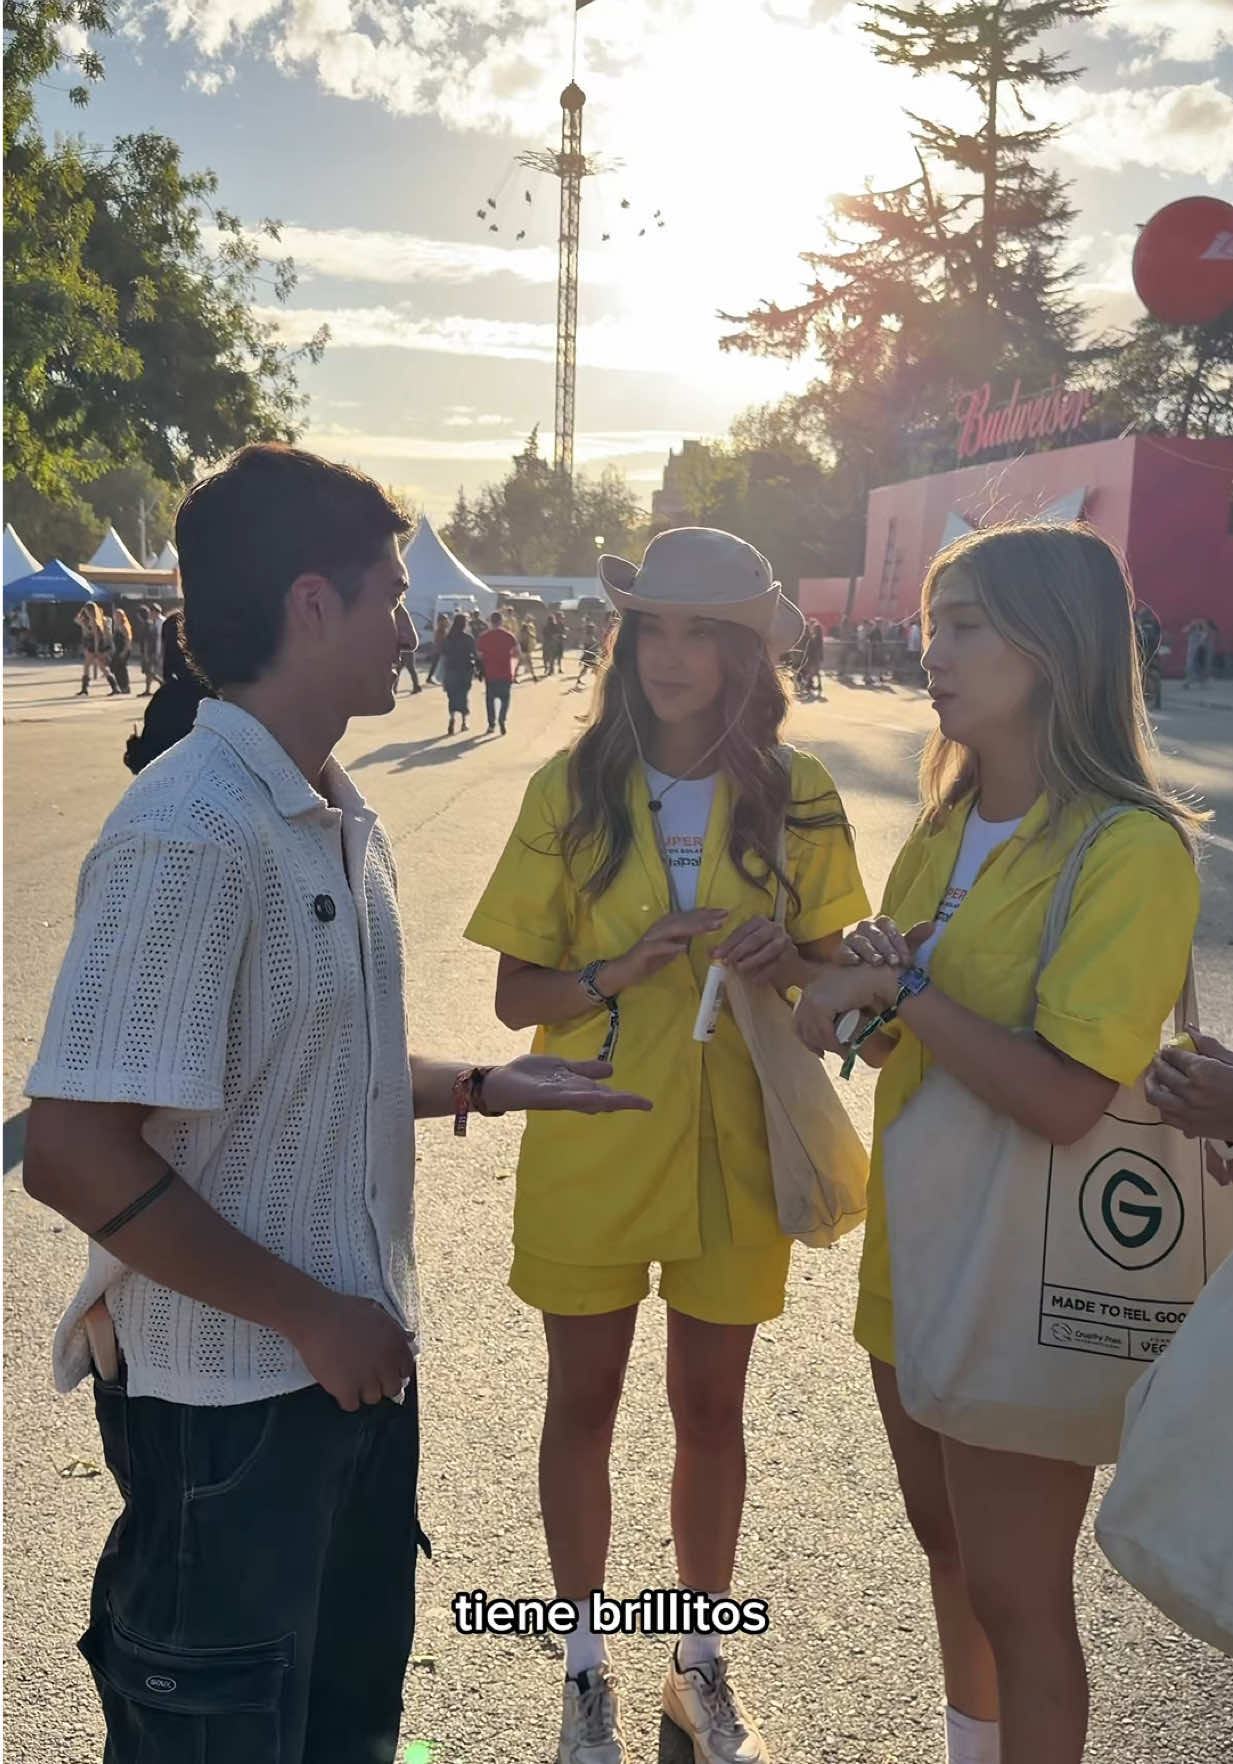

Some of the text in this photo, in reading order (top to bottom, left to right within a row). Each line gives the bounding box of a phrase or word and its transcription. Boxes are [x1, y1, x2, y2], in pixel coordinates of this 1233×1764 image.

[955, 373, 1092, 459] Budweiser
[1101, 1169, 1162, 1248] G
[1052, 1295, 1096, 1313] MADE
[1100, 1303, 1121, 1318] TO
[1155, 1311, 1187, 1324] GOO
